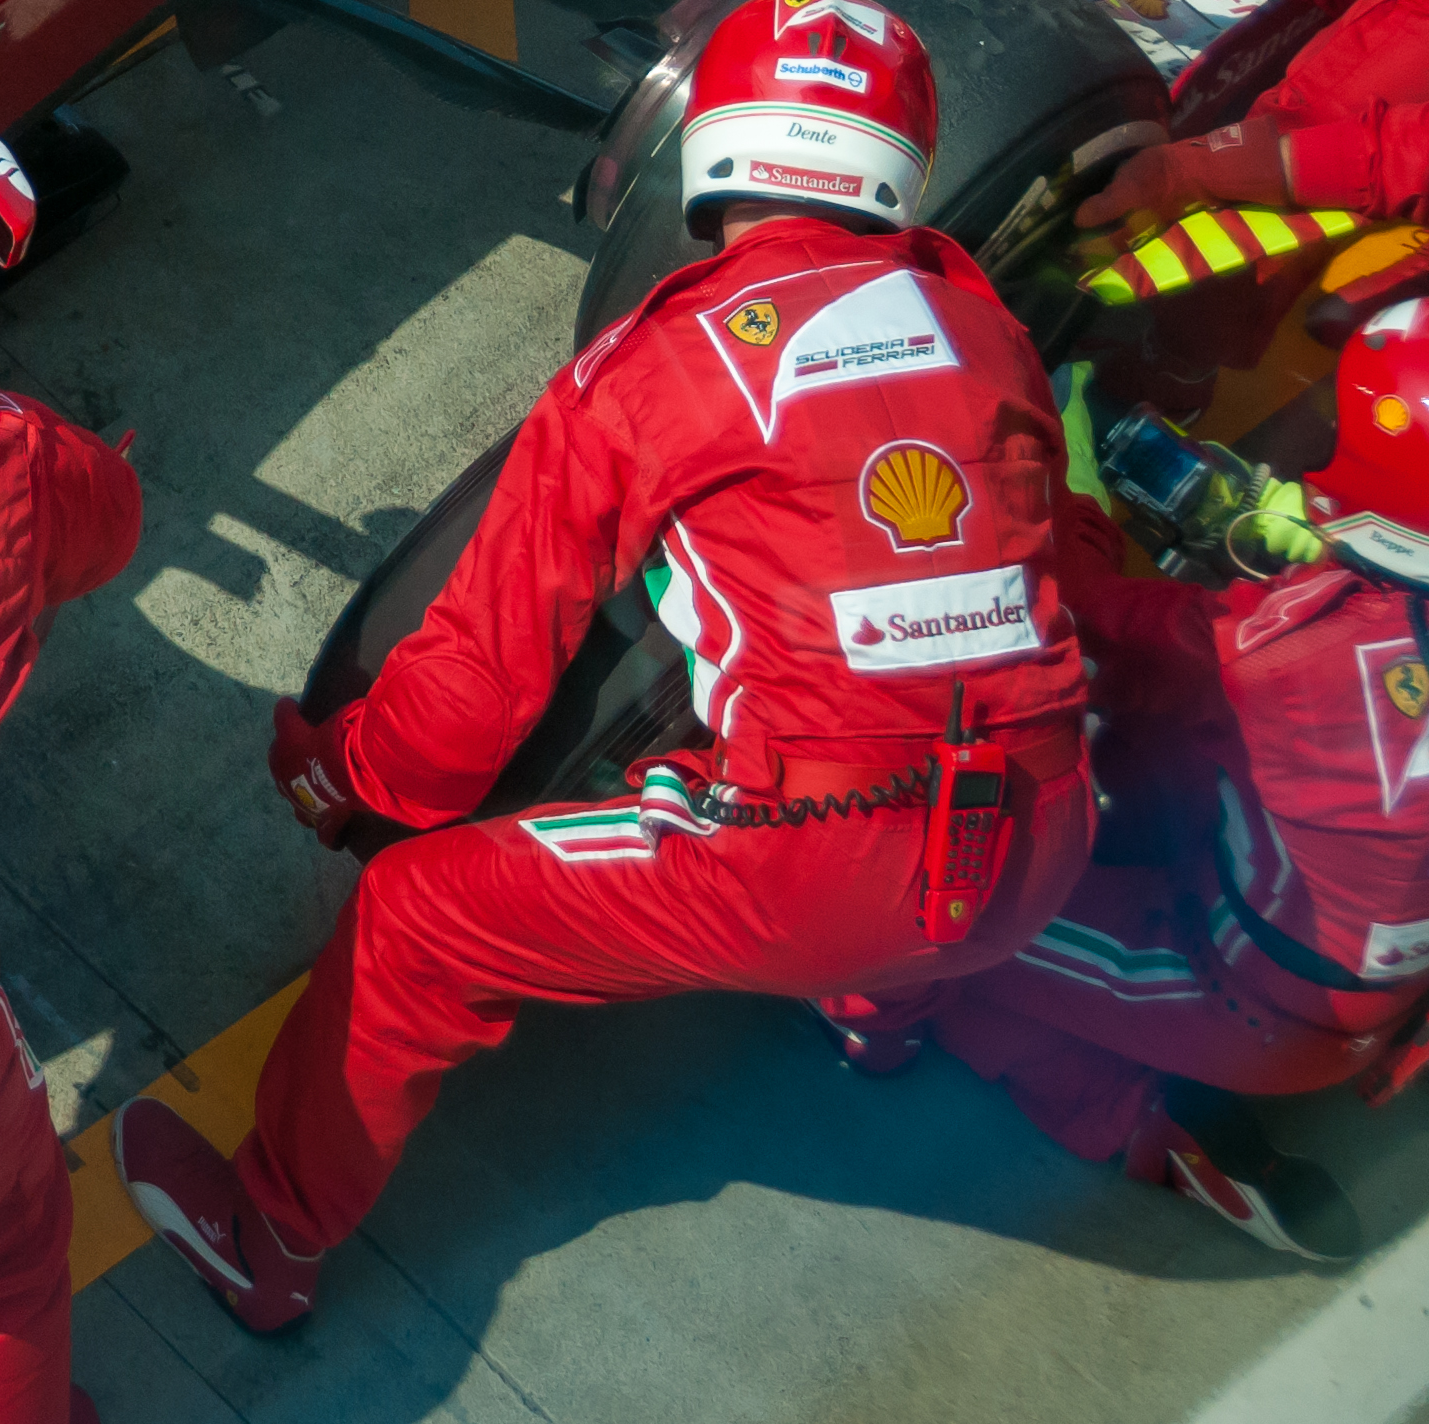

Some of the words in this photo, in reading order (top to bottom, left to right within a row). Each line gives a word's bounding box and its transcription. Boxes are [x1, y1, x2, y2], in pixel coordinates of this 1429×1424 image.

[779, 63, 846, 82] Schuberth
[786, 122, 838, 145] Dente
[770, 167, 857, 193] Santander
[795, 338, 906, 366] SCUDERIA
[842, 345, 936, 369] FERRARI
[888, 595, 1026, 642] Santander
